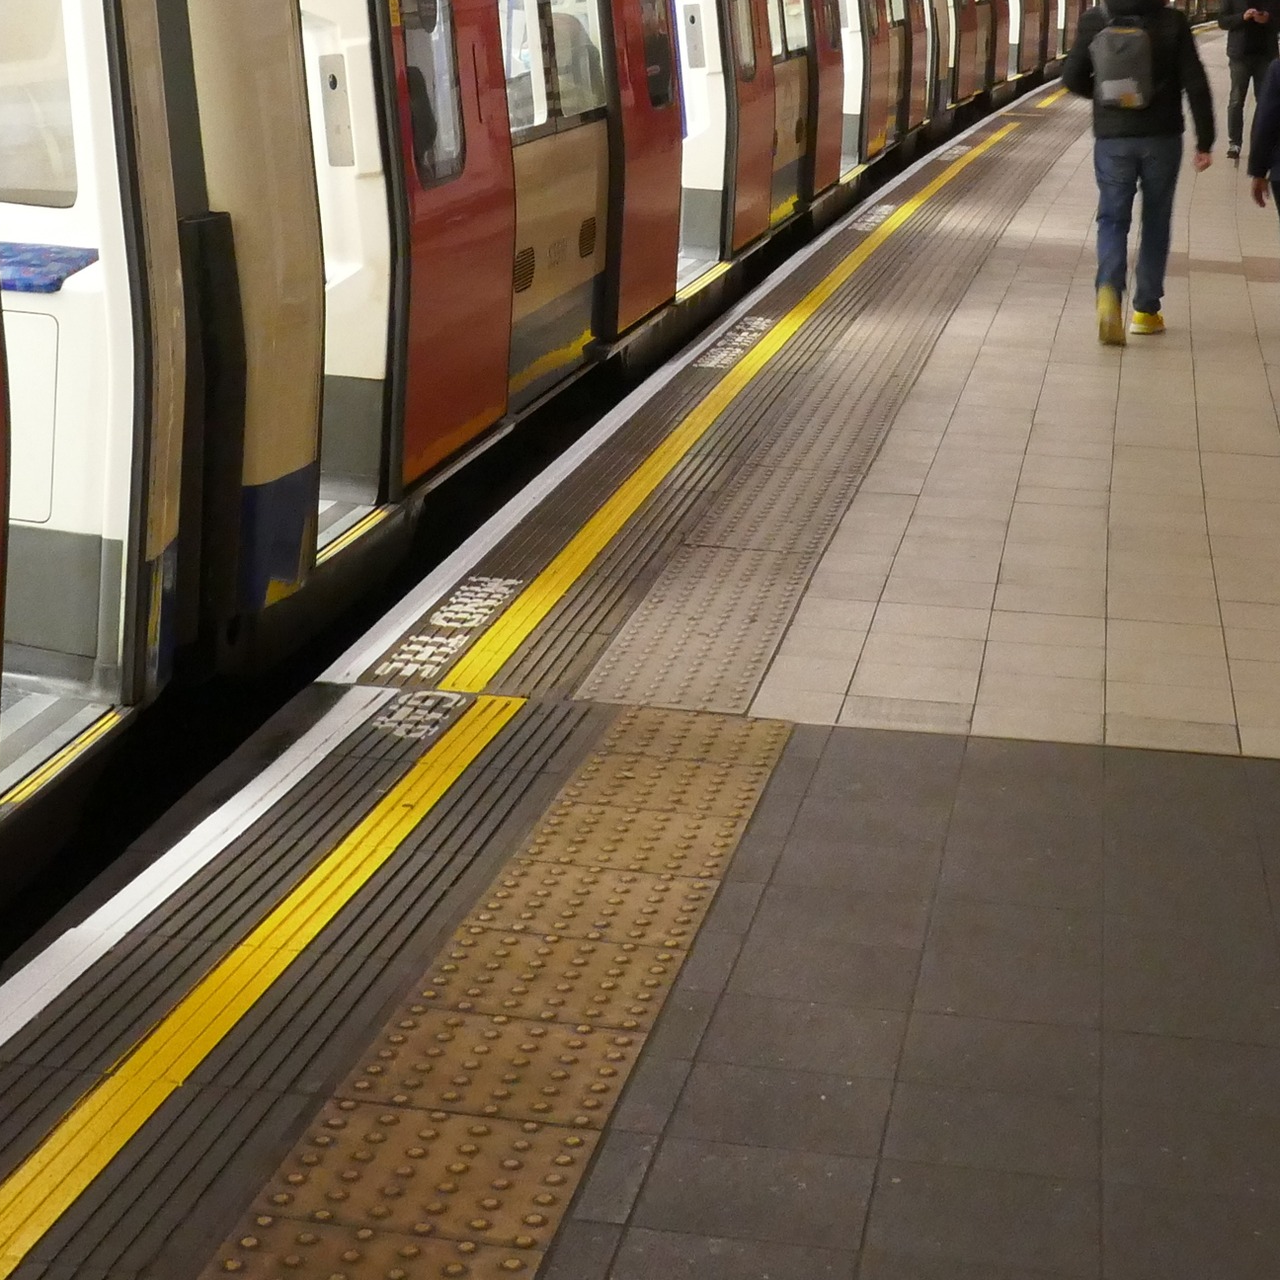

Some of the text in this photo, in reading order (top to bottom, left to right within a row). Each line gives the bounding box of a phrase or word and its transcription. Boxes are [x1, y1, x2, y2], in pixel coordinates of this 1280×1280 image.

[429, 576, 523, 628] MIND
[375, 634, 470, 678] THE
[372, 690, 466, 740] GAP
